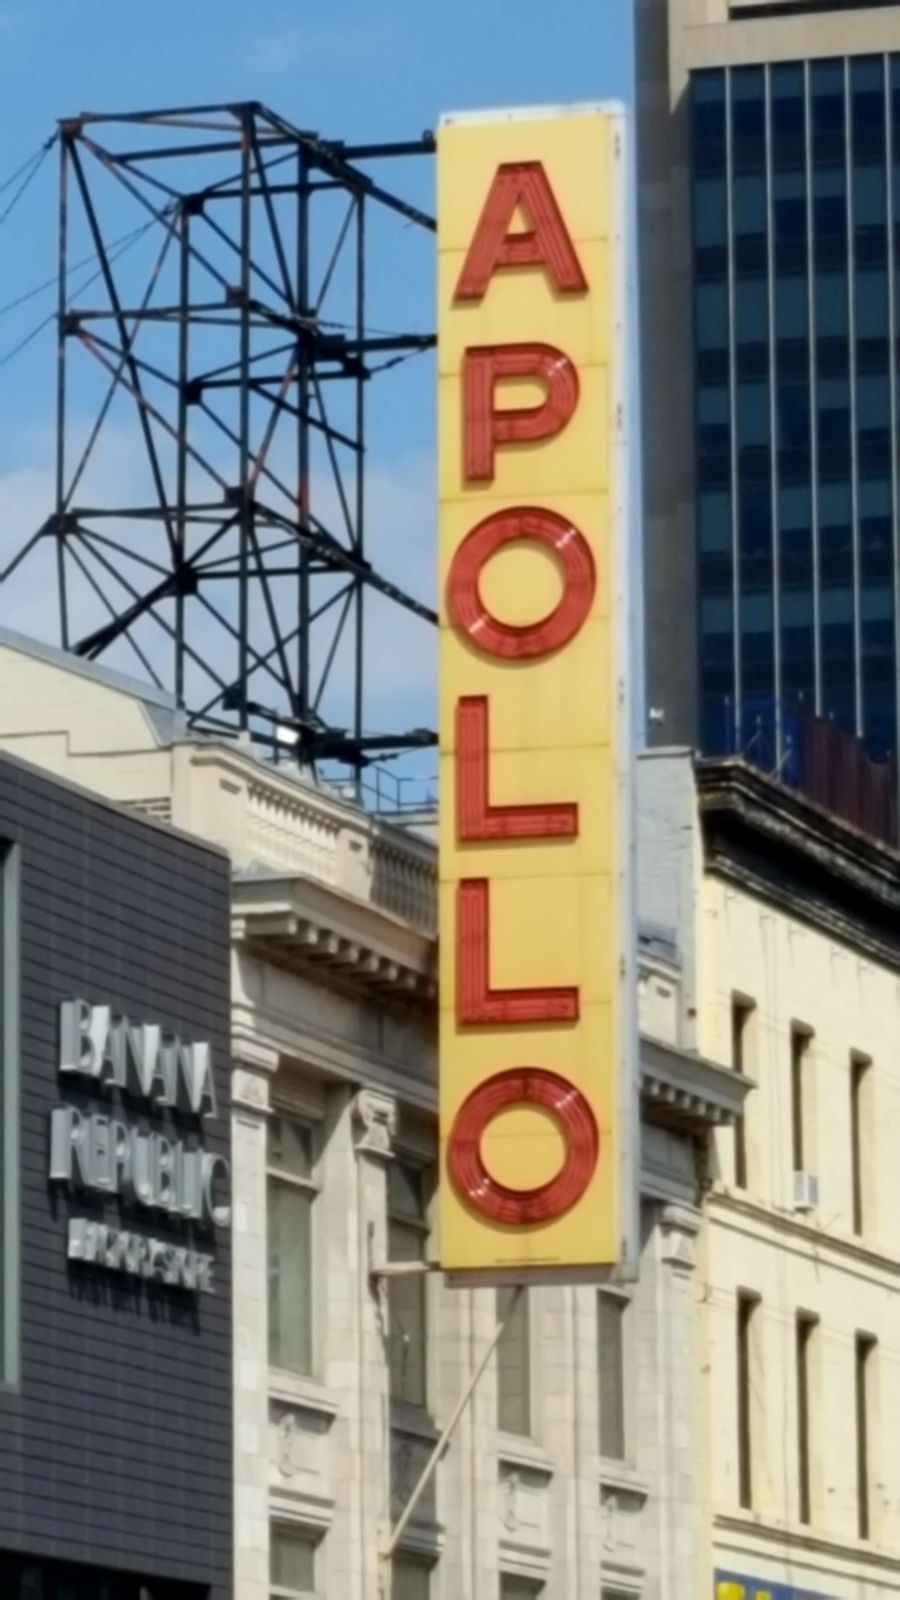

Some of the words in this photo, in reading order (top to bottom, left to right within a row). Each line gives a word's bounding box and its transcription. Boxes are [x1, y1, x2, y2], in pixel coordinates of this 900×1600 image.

[445, 160, 600, 1227] APOLLO
[59, 998, 217, 1118] BANANA
[50, 1105, 231, 1227] REPUBLIC
